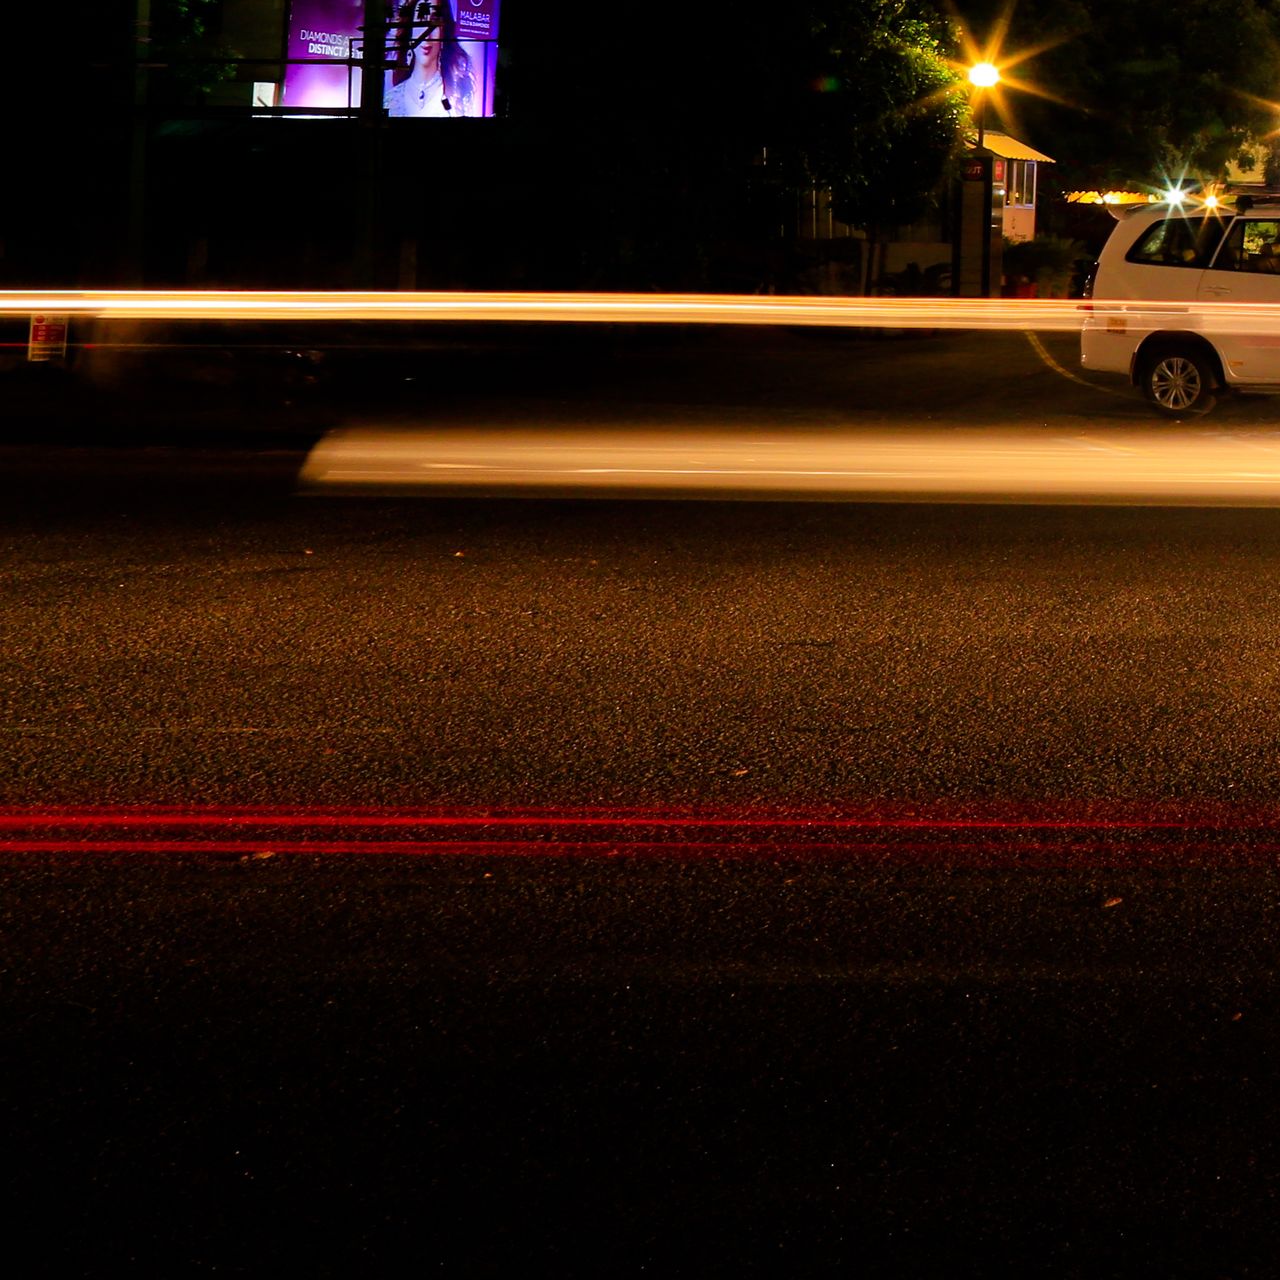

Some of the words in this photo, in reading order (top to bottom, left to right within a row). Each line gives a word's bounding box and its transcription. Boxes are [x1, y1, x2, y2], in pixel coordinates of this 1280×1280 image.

[459, 9, 490, 23] MALABAR
[300, 29, 343, 45] DIAMONDS
[308, 42, 344, 56] DISTINCT
